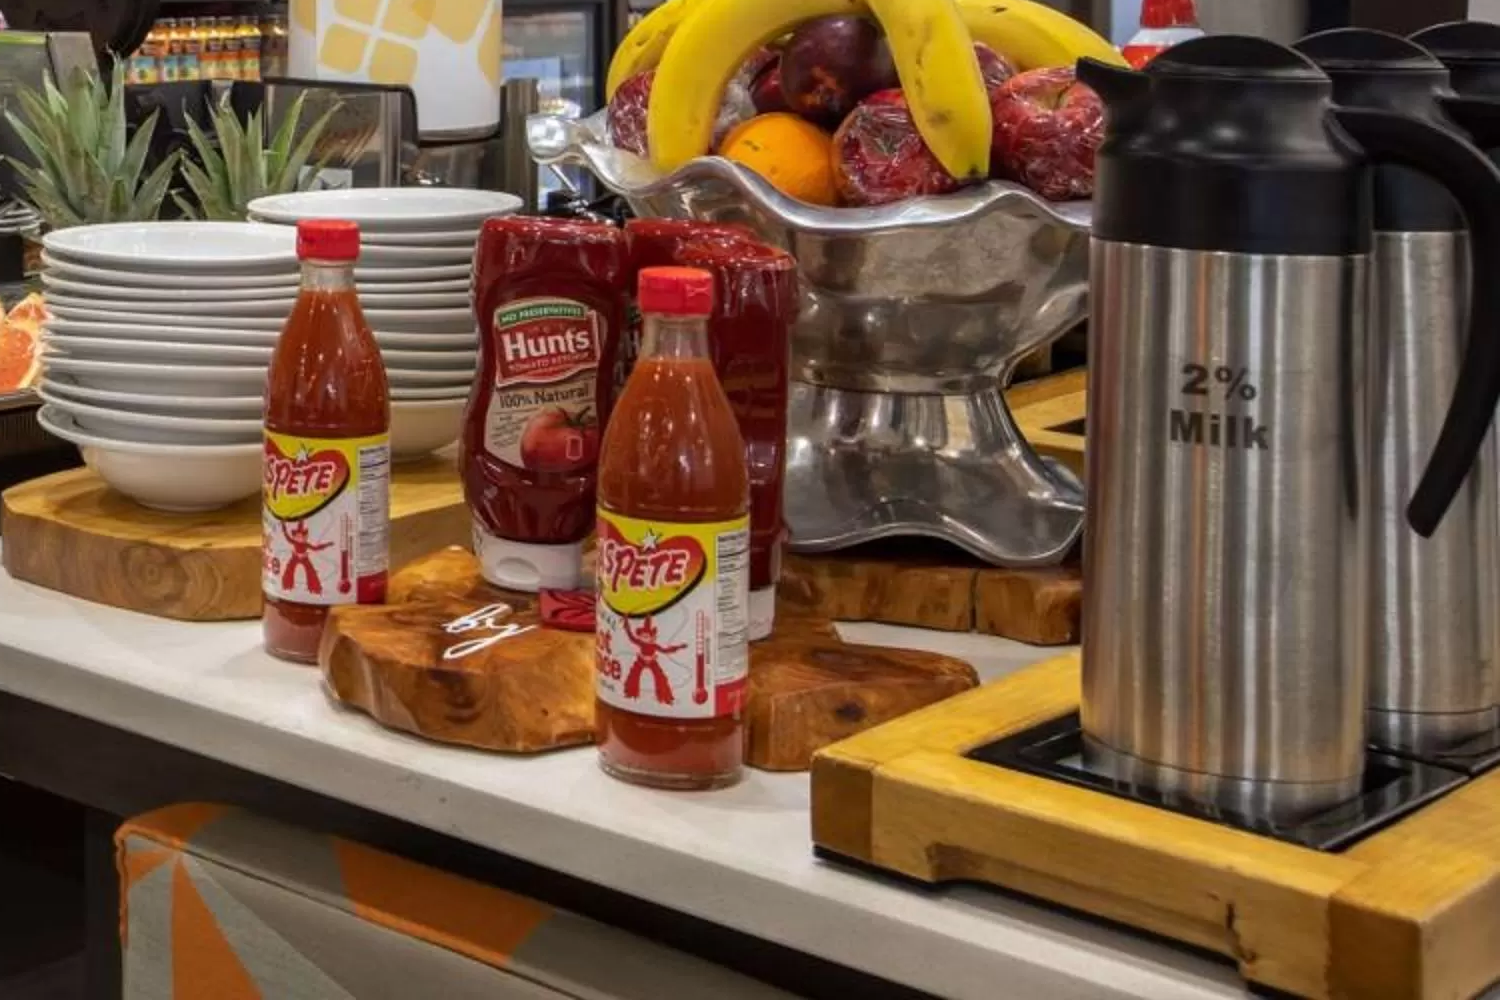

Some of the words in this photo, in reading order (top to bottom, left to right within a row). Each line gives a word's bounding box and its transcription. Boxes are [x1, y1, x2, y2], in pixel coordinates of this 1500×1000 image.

[534, 384, 589, 404] Natural
[1181, 363, 1257, 401] 2%
[1170, 408, 1269, 450] Milk
